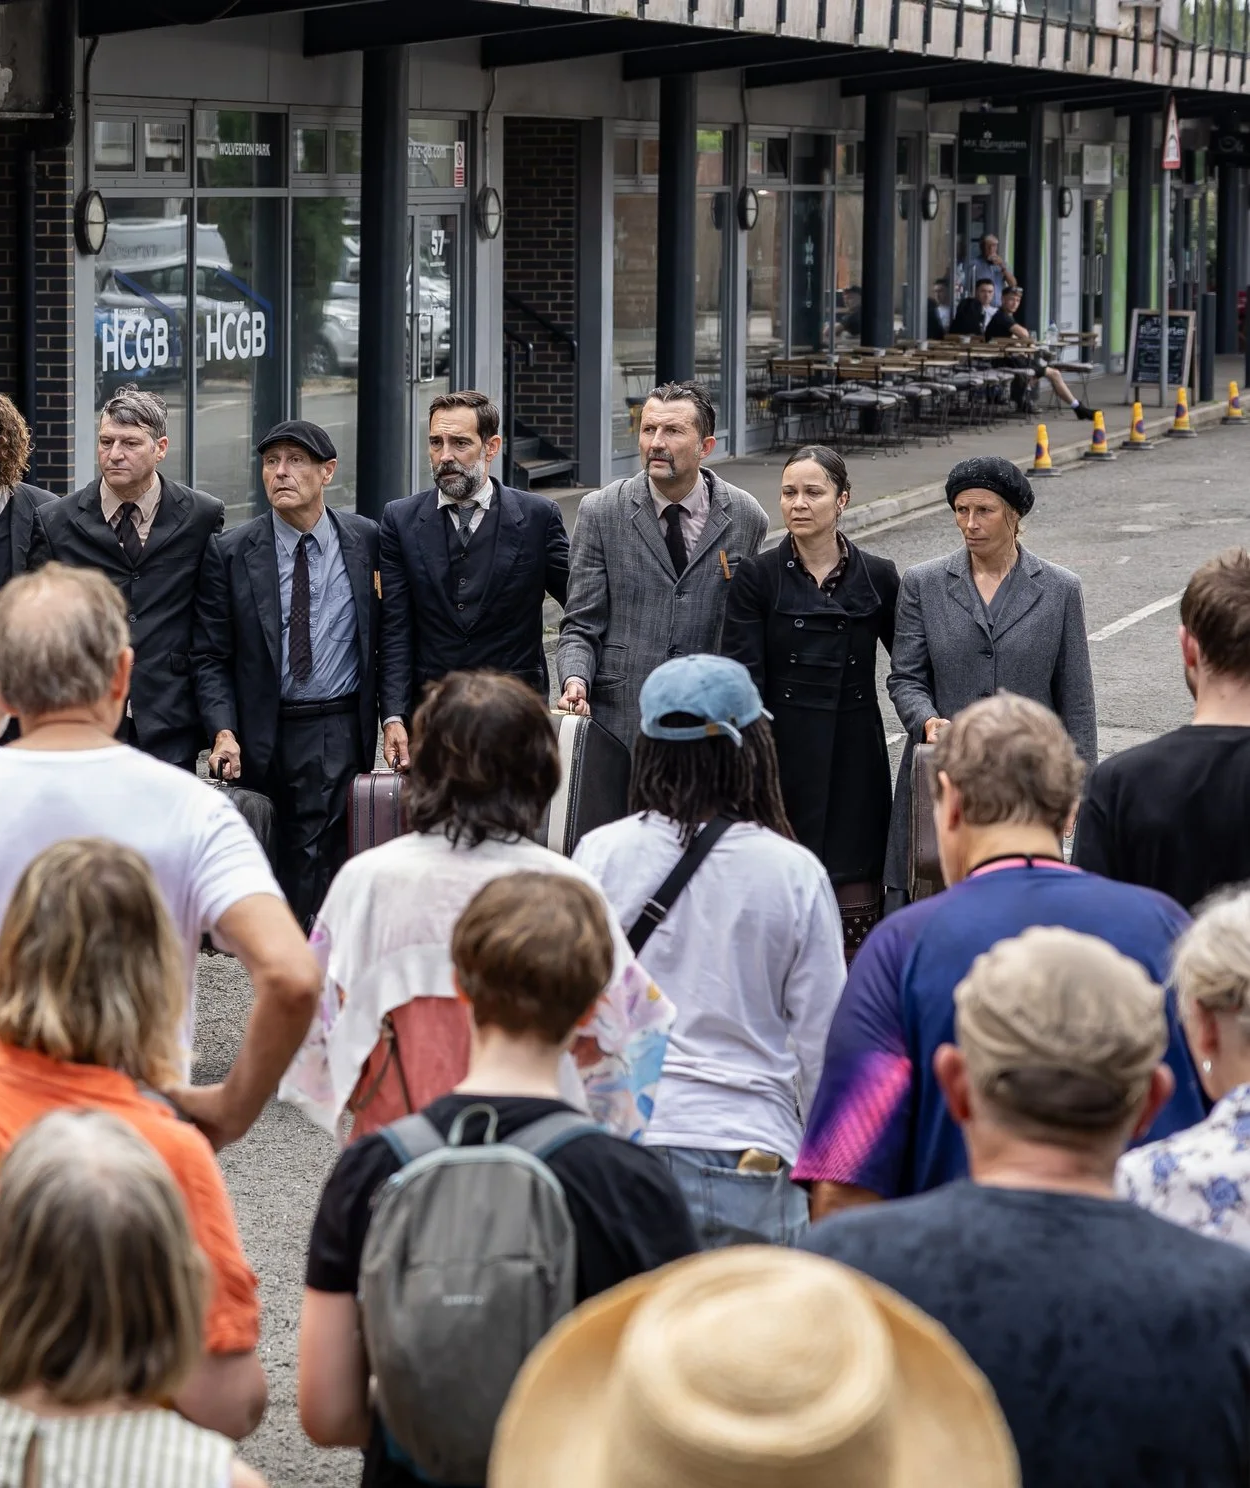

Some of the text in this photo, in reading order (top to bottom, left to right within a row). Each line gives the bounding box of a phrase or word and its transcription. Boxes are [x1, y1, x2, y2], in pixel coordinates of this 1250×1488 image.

[219, 142, 254, 156] WOLVERTON
[255, 143, 270, 156] PARK
[431, 230, 445, 256] 57
[102, 308, 168, 372] HCGB
[206, 302, 266, 361] HCGB
